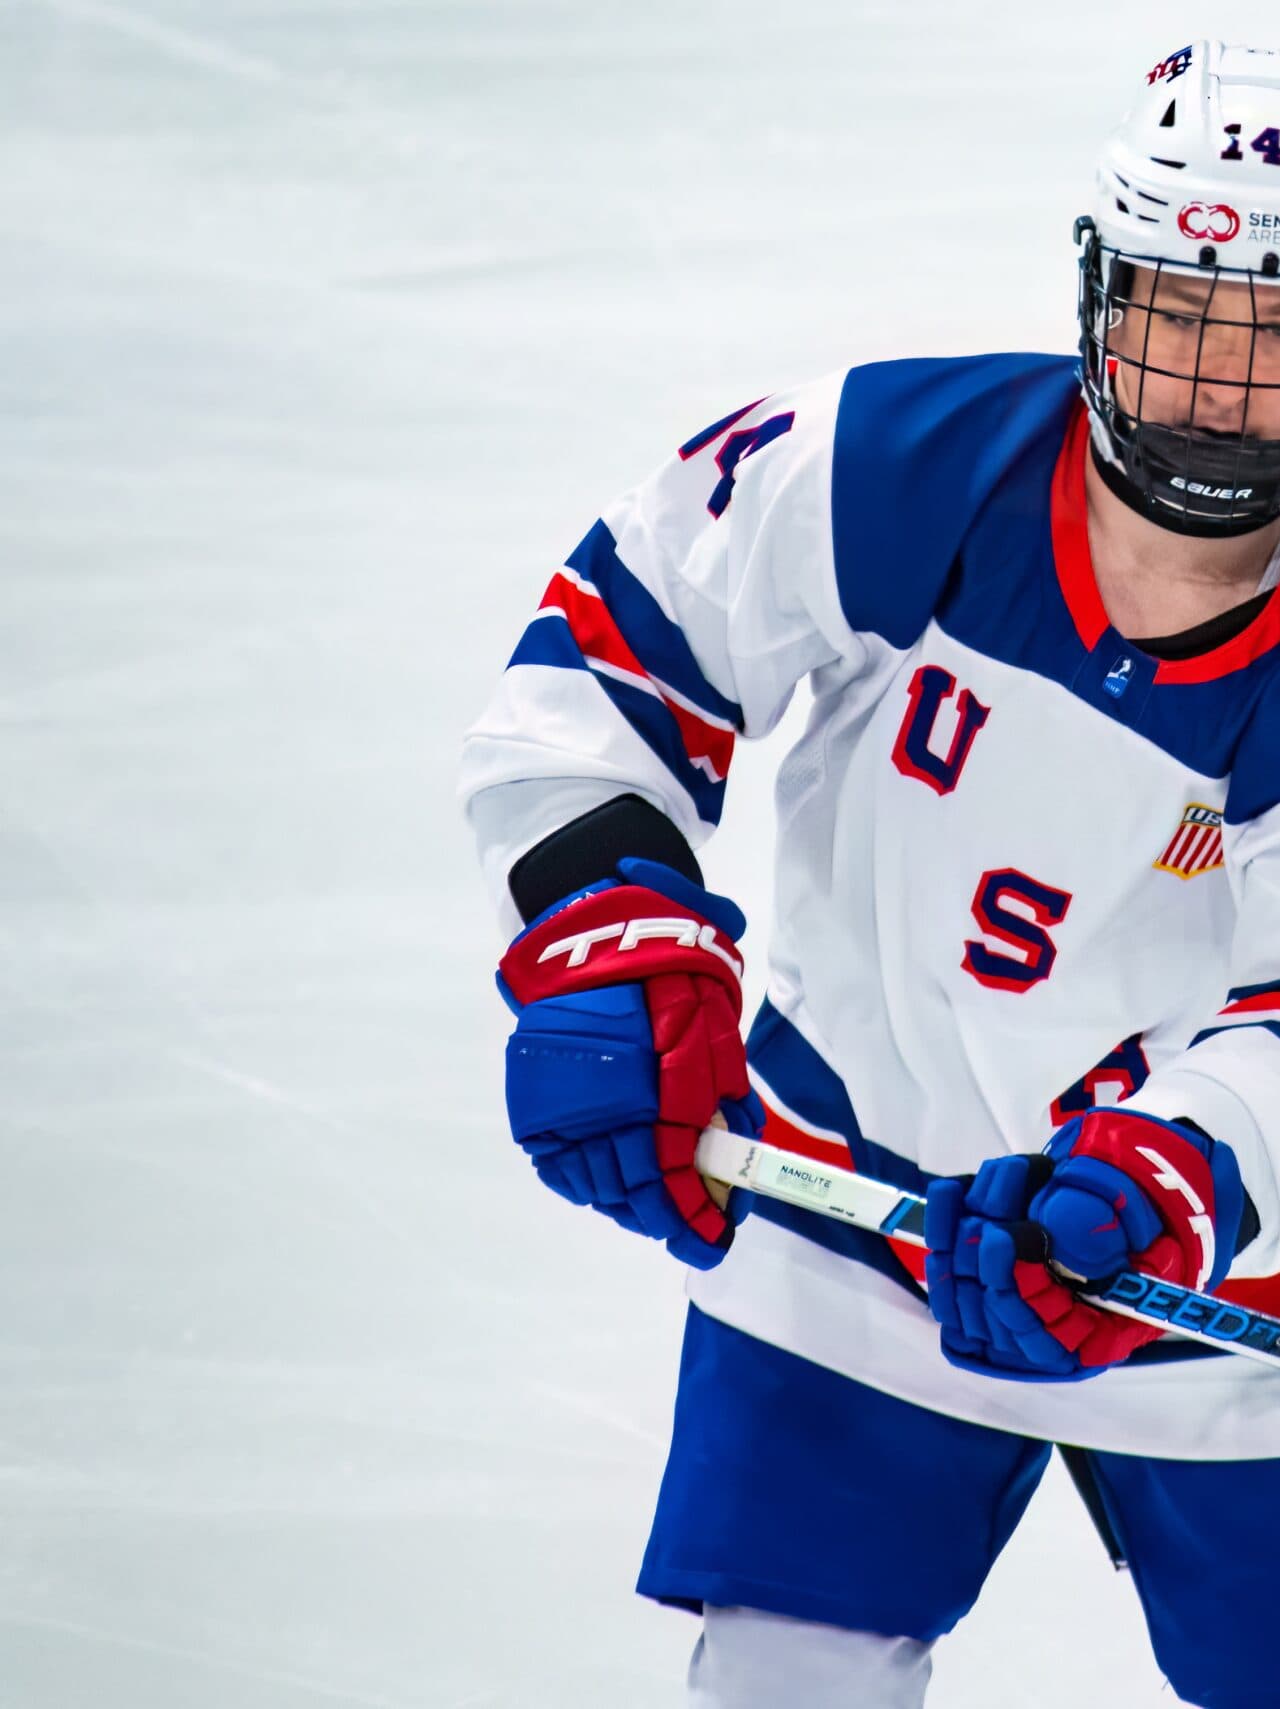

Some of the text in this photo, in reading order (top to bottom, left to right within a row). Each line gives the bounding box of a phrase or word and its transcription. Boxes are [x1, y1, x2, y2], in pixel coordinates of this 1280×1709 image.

[1170, 476, 1253, 499] BAUER
[890, 664, 992, 797] U
[960, 866, 1073, 995] S
[781, 1164, 833, 1189] NANOLITE
[1102, 1272, 1250, 1342] PEED
